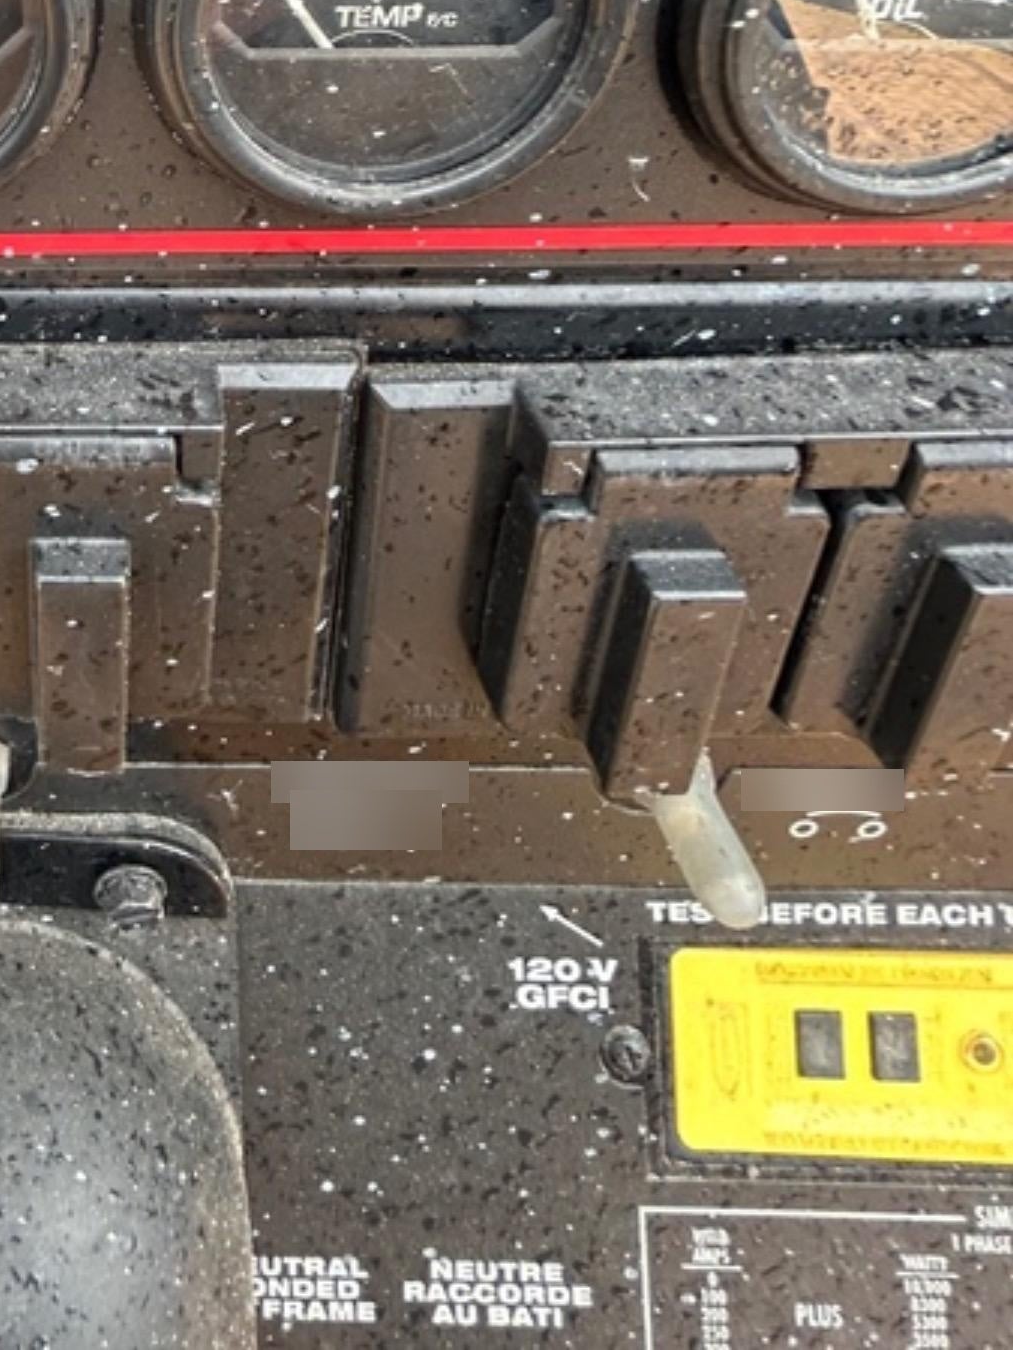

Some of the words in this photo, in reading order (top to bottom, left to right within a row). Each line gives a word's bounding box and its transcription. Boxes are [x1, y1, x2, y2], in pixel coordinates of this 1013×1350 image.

[335, 3, 423, 28] TEMP
[763, 902, 888, 926] EFORE
[896, 904, 994, 926] EACH
[507, 957, 581, 982] 120
[588, 958, 619, 982] V
[516, 984, 610, 1010] GFCI
[251, 1255, 369, 1280] UTRAL
[430, 1258, 564, 1282] NEUTRE
[252, 1278, 361, 1301] ONDED
[403, 1280, 593, 1307] RACCORDE
[262, 1298, 378, 1323] FRAME
[431, 1304, 478, 1327] AU
[487, 1306, 564, 1329] BATI
[793, 1302, 844, 1329] PLUS
